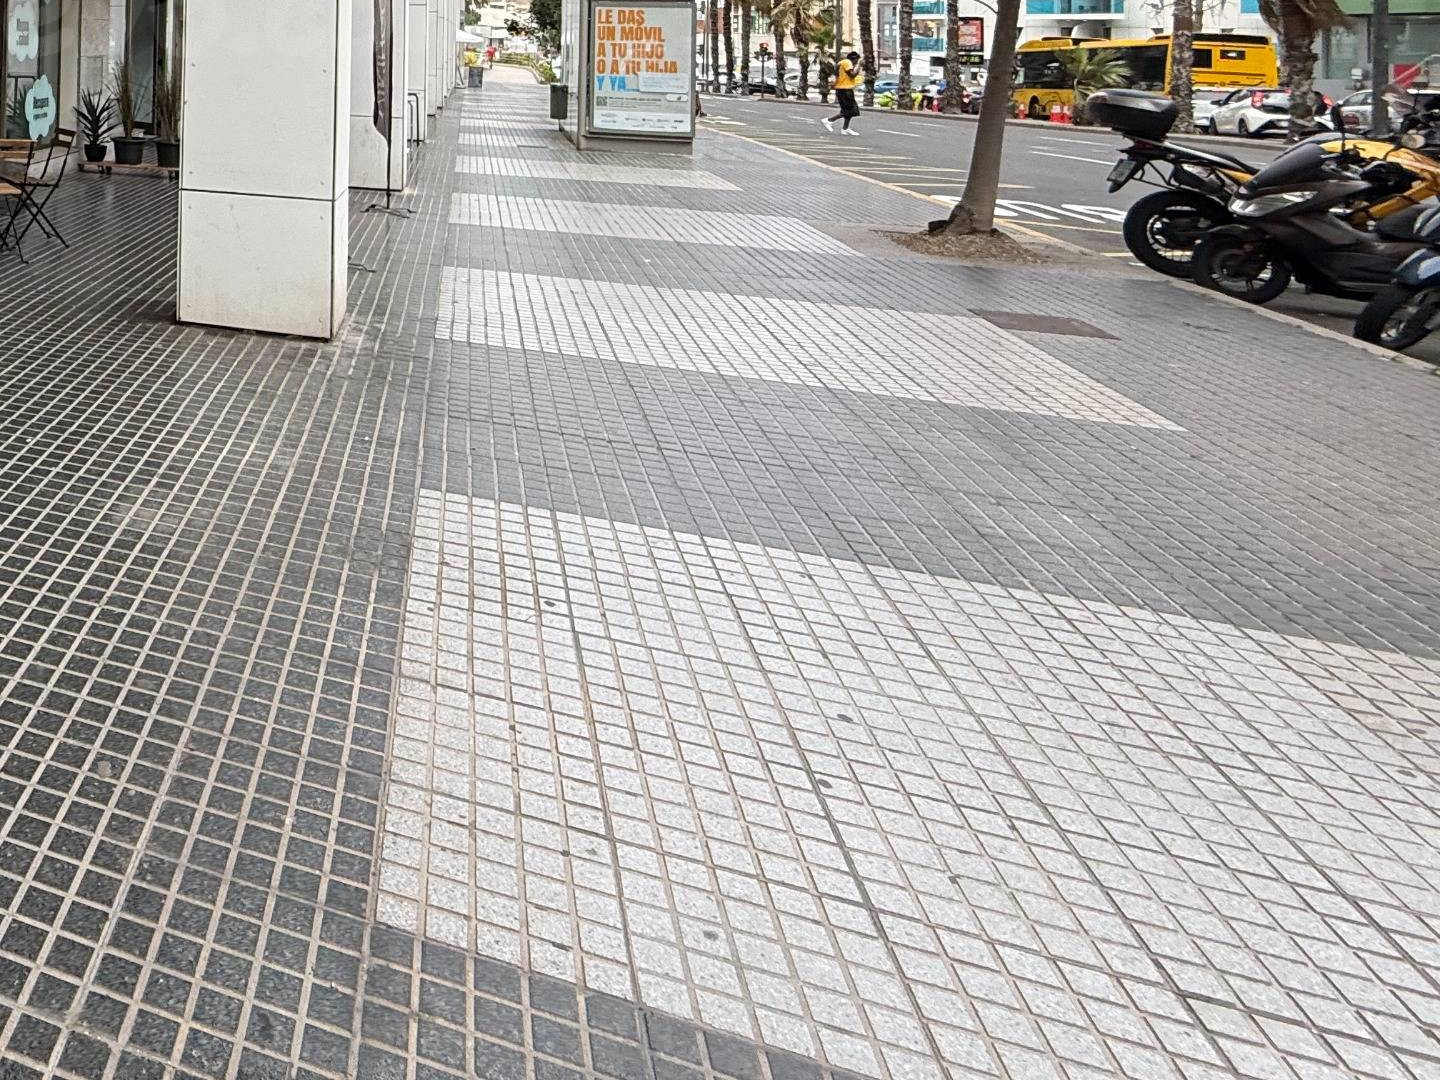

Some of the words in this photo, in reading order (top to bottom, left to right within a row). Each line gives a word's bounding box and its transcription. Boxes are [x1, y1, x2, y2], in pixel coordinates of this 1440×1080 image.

[597, 9, 613, 25] LE
[617, 9, 645, 26] DAS
[597, 25, 616, 41] UN
[620, 23, 665, 42] MÓVIL
[596, 42, 606, 57] A
[610, 42, 628, 58] TU
[632, 43, 664, 59] HIJO
[596, 59, 606, 74] O
[610, 59, 620, 75] A
[624, 60, 641, 76] TU
[645, 60, 678, 74] HIJA
[596, 75, 605, 91] Y
